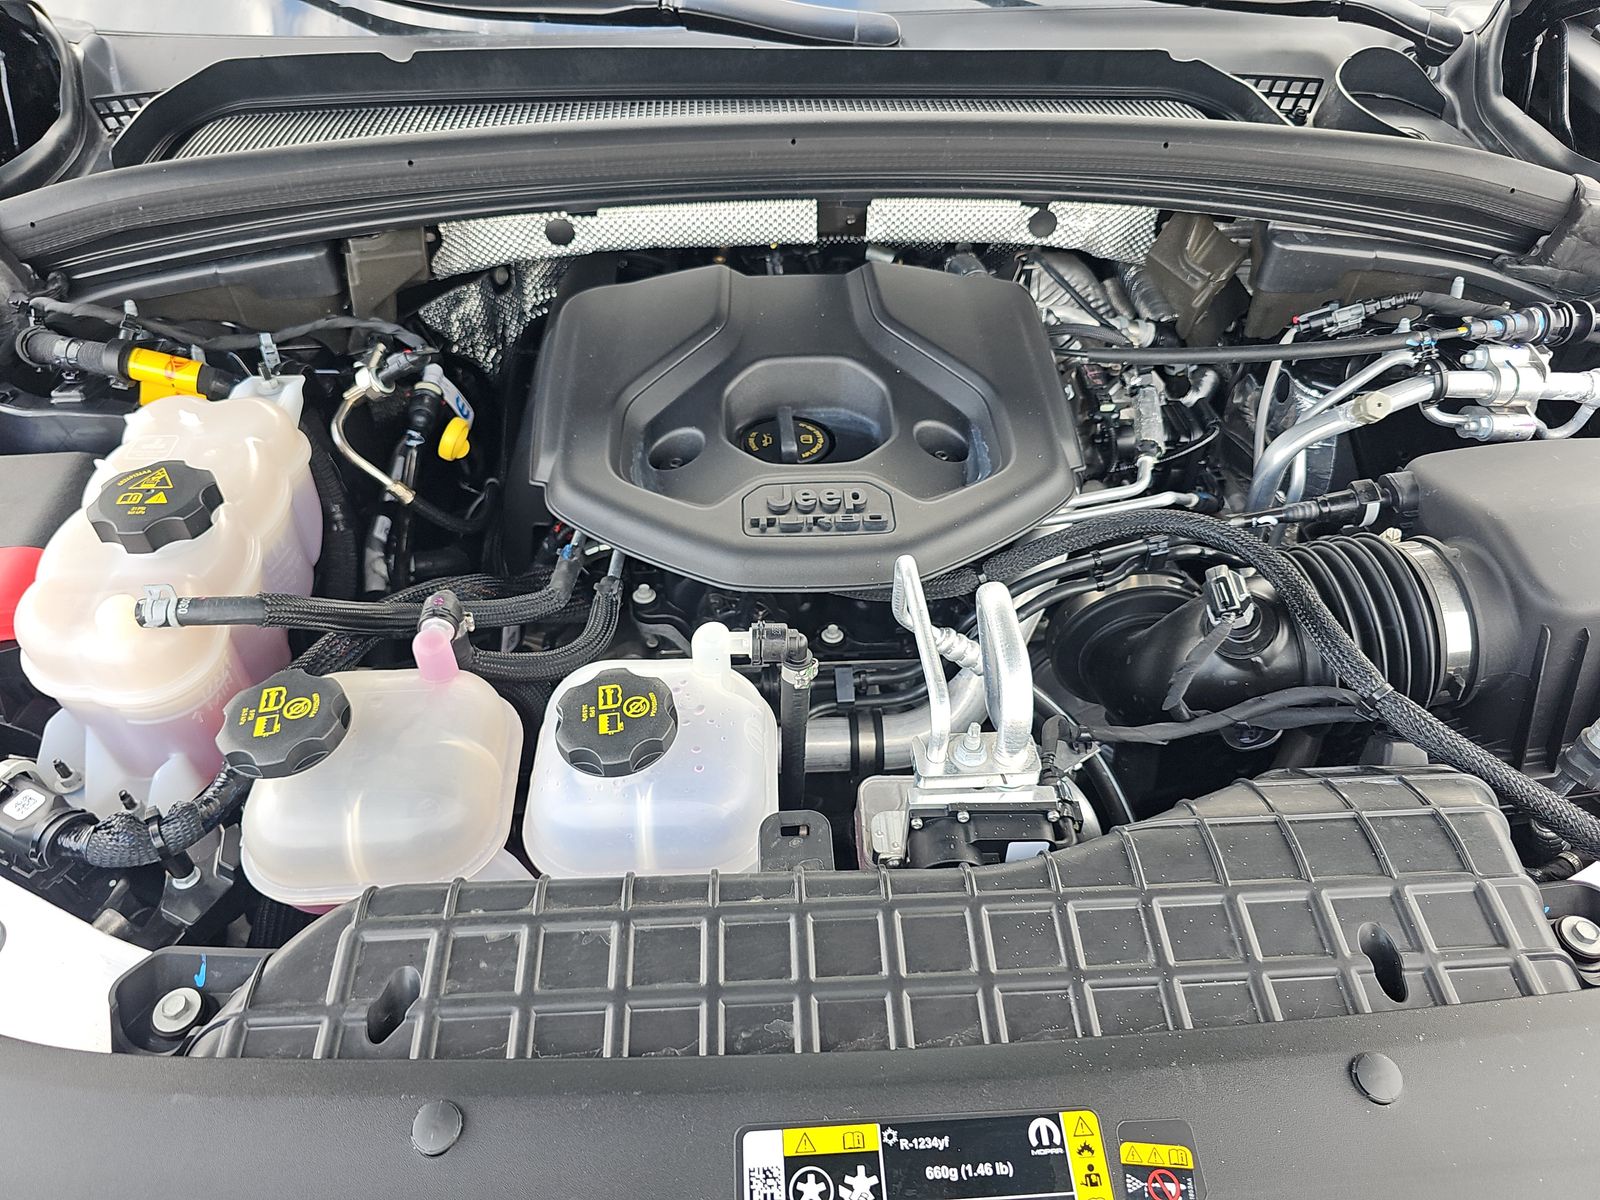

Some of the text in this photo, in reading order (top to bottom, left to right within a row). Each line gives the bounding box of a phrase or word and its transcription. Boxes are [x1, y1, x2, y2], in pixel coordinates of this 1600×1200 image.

[767, 485, 868, 514] Jeep
[899, 1135, 950, 1151] R-1234yf
[925, 1161, 1014, 1182] 660g (1.46 lb)
